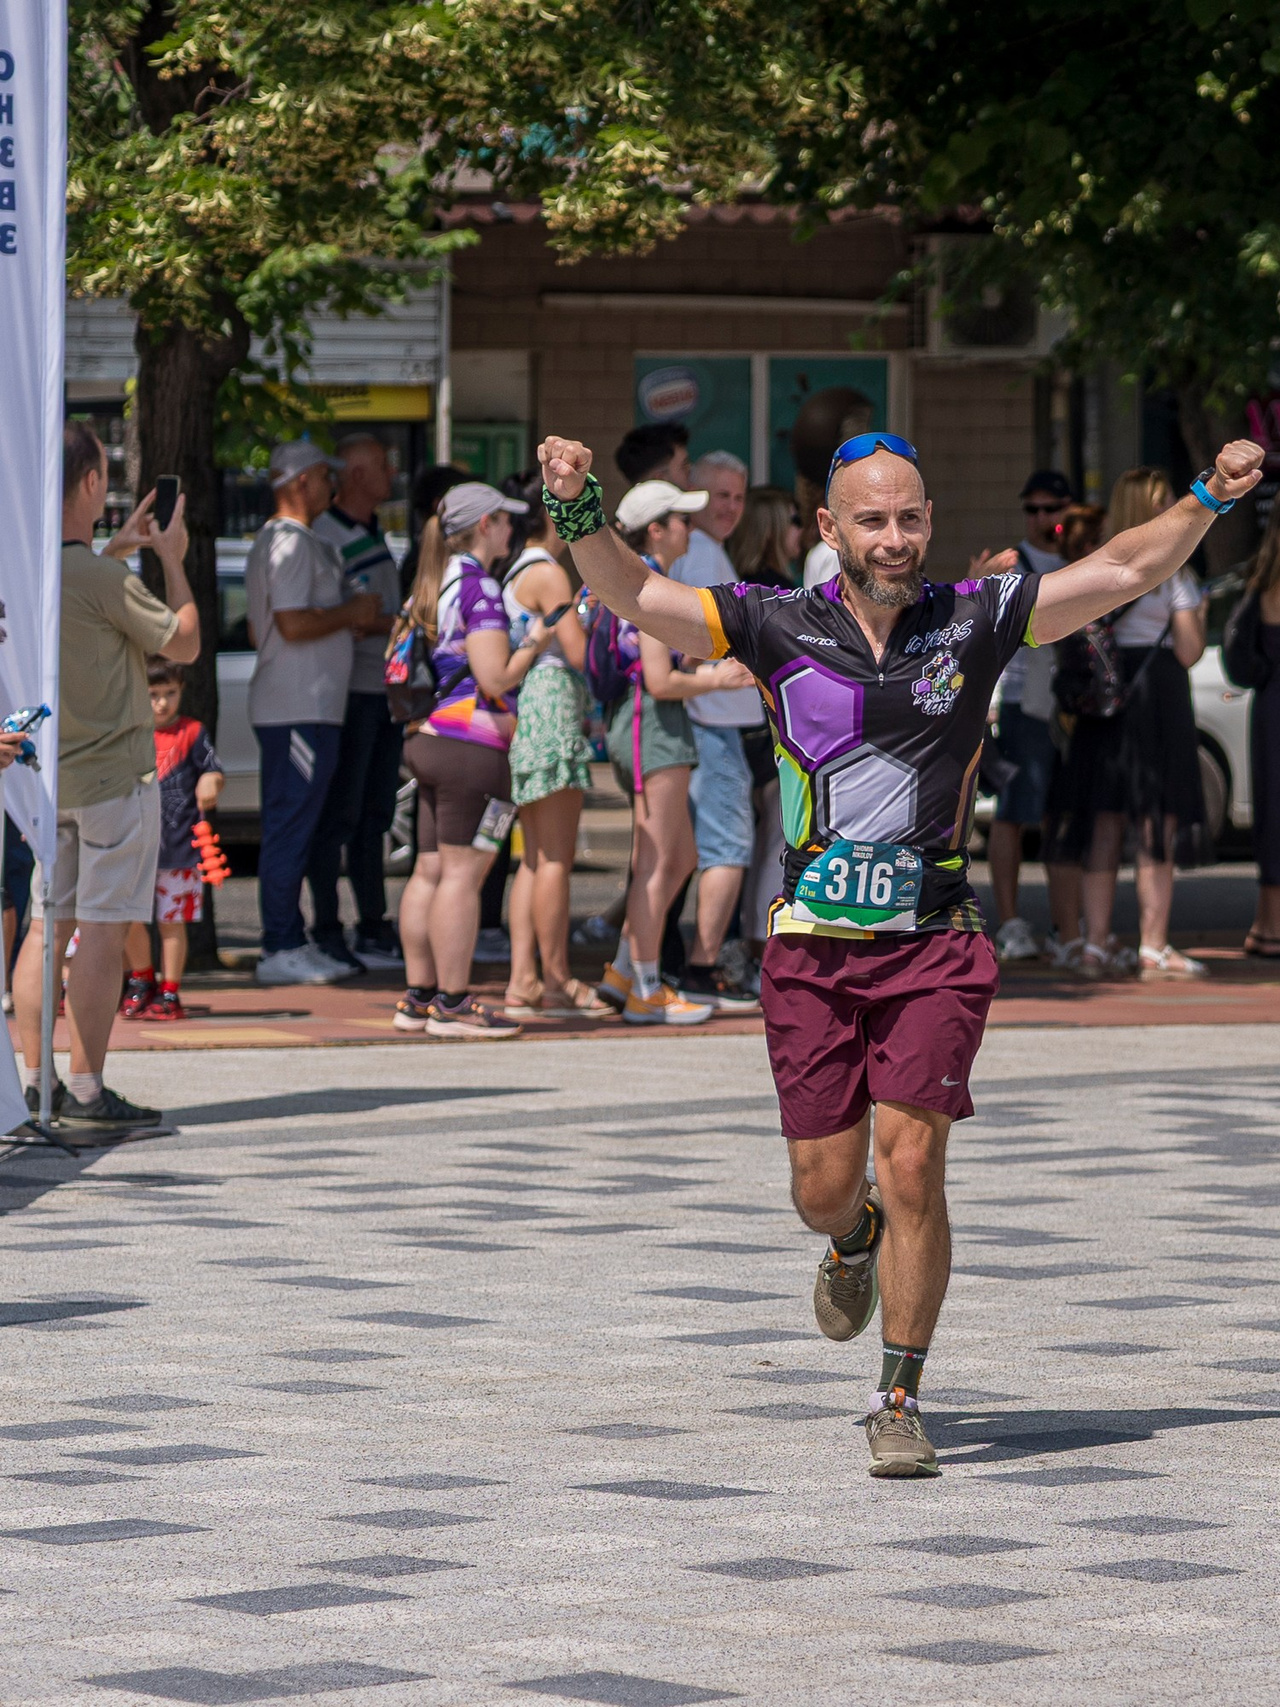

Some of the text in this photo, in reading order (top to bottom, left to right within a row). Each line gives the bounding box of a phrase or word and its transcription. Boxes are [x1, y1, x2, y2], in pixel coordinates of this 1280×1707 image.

[852, 851, 874, 859] NIKOLOV
[825, 857, 894, 905] 316
[799, 885, 809, 896] 21
